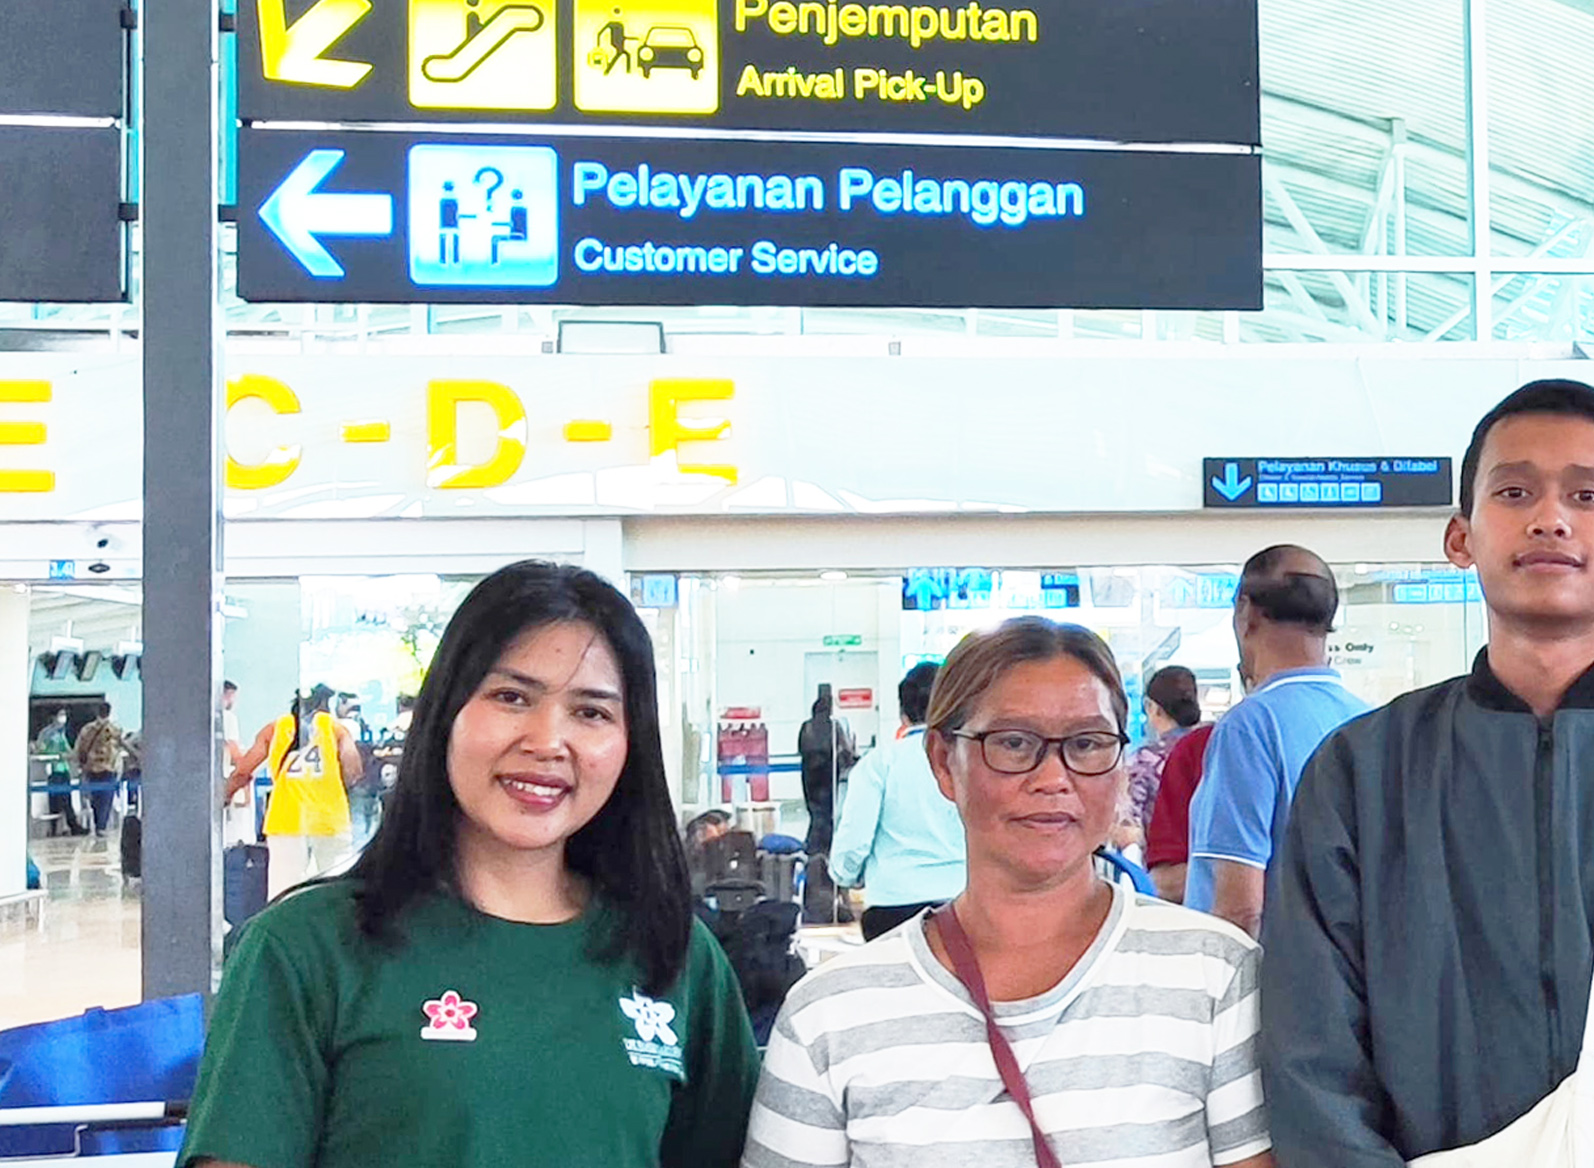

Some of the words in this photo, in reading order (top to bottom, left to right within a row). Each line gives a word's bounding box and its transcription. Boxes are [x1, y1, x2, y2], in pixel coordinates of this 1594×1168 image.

[736, 0, 1037, 45] Penjemputan
[737, 65, 845, 99] Arrival
[854, 68, 984, 109] Pick-Up
[572, 162, 823, 218] Pelayanan
[838, 168, 1083, 225] Pelanggan
[572, 237, 744, 275] Customer
[750, 240, 880, 277] Service
[1258, 461, 1325, 474] Pelayanan
